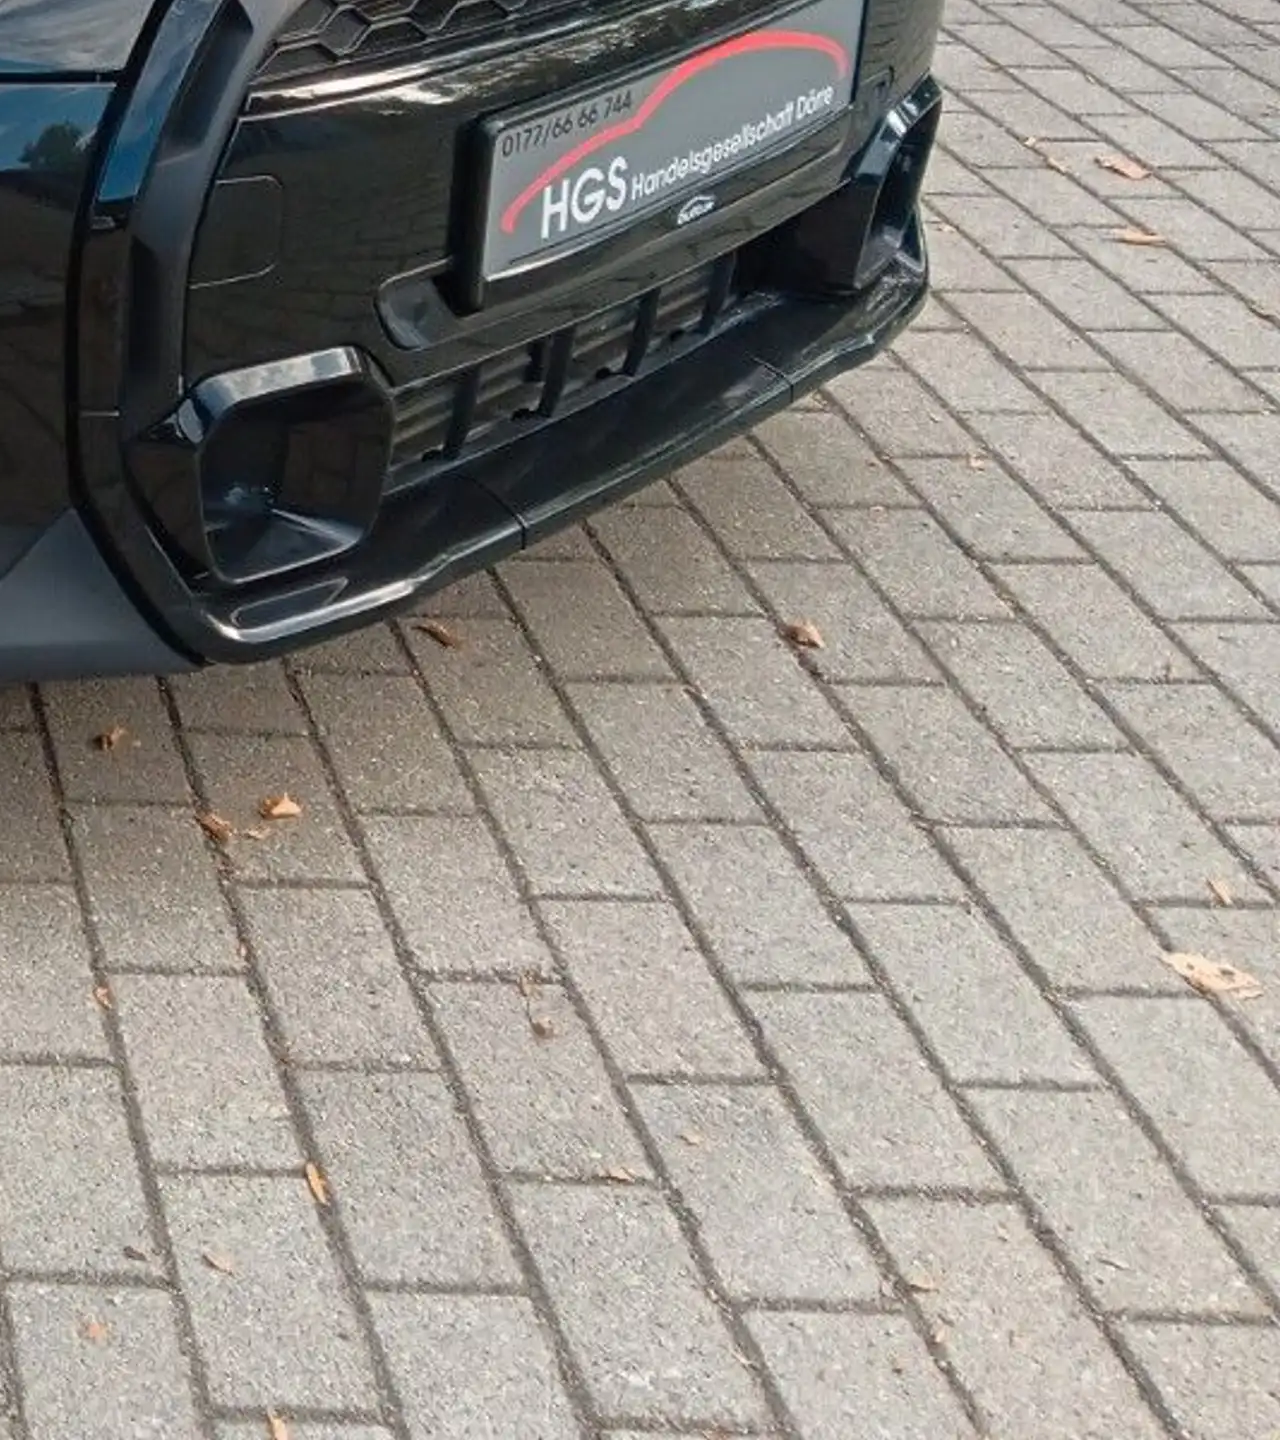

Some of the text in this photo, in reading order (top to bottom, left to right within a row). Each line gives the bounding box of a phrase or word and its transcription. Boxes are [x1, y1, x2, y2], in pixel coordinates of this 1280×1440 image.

[502, 90, 632, 157] 0177/66 66 744
[541, 156, 628, 239] HGS
[631, 101, 794, 200] Handelsgesellschaft
